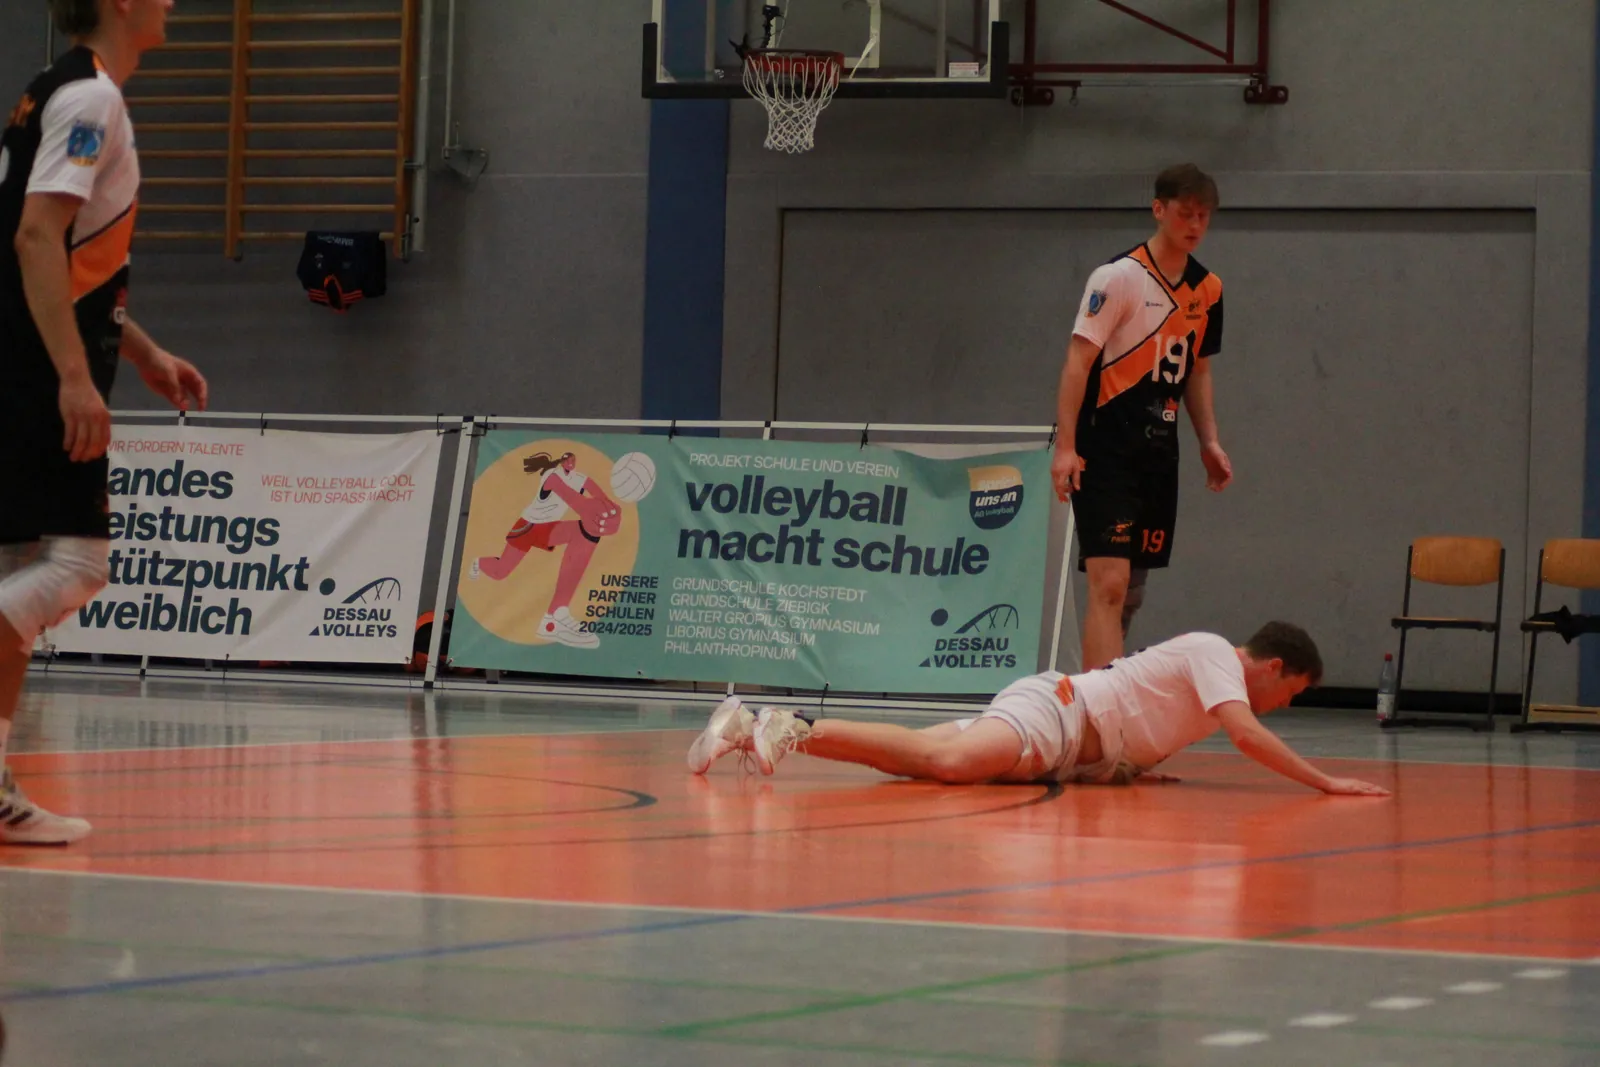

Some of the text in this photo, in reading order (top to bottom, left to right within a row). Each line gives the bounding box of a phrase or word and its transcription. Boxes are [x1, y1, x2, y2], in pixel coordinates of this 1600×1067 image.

[1152, 333, 1189, 384] 19
[188, 442, 245, 456] TALENTE
[689, 453, 899, 479] PROJEKT SCHULE UND VEREIN
[108, 459, 234, 499] andes
[261, 475, 292, 488] WEIL
[296, 476, 377, 490] VOLLEYBALL
[270, 490, 292, 502] IST
[294, 491, 322, 504] UND
[324, 492, 367, 504] SPASS
[686, 474, 908, 527] volleyball
[975, 491, 1017, 507] uns an
[108, 503, 279, 555] eistungs
[677, 524, 989, 577] macht schule
[1141, 529, 1165, 553] 19
[108, 548, 310, 600] tützpunkt
[601, 575, 659, 588] UNSERE
[588, 590, 656, 604] PARTNER
[672, 577, 868, 602] GRUNDSCHULE KOCHSTEDT
[79, 593, 252, 635] weiblich
[323, 607, 391, 621] DESSAU
[585, 605, 654, 620] SCHULEN
[670, 593, 831, 615] GRUNDSCHULE ZIEBIGK
[323, 624, 397, 637] VOLLEYS
[579, 621, 652, 636] 2024/2025
[669, 609, 880, 635] WALTER GROPIUS GYMNASIUM
[666, 625, 816, 646] LIBORIUS GYMNASIUM
[934, 637, 1009, 652] DESSAU
[664, 641, 797, 660] PHILANTHROPINUM
[934, 654, 1016, 668] VOLLEYS
